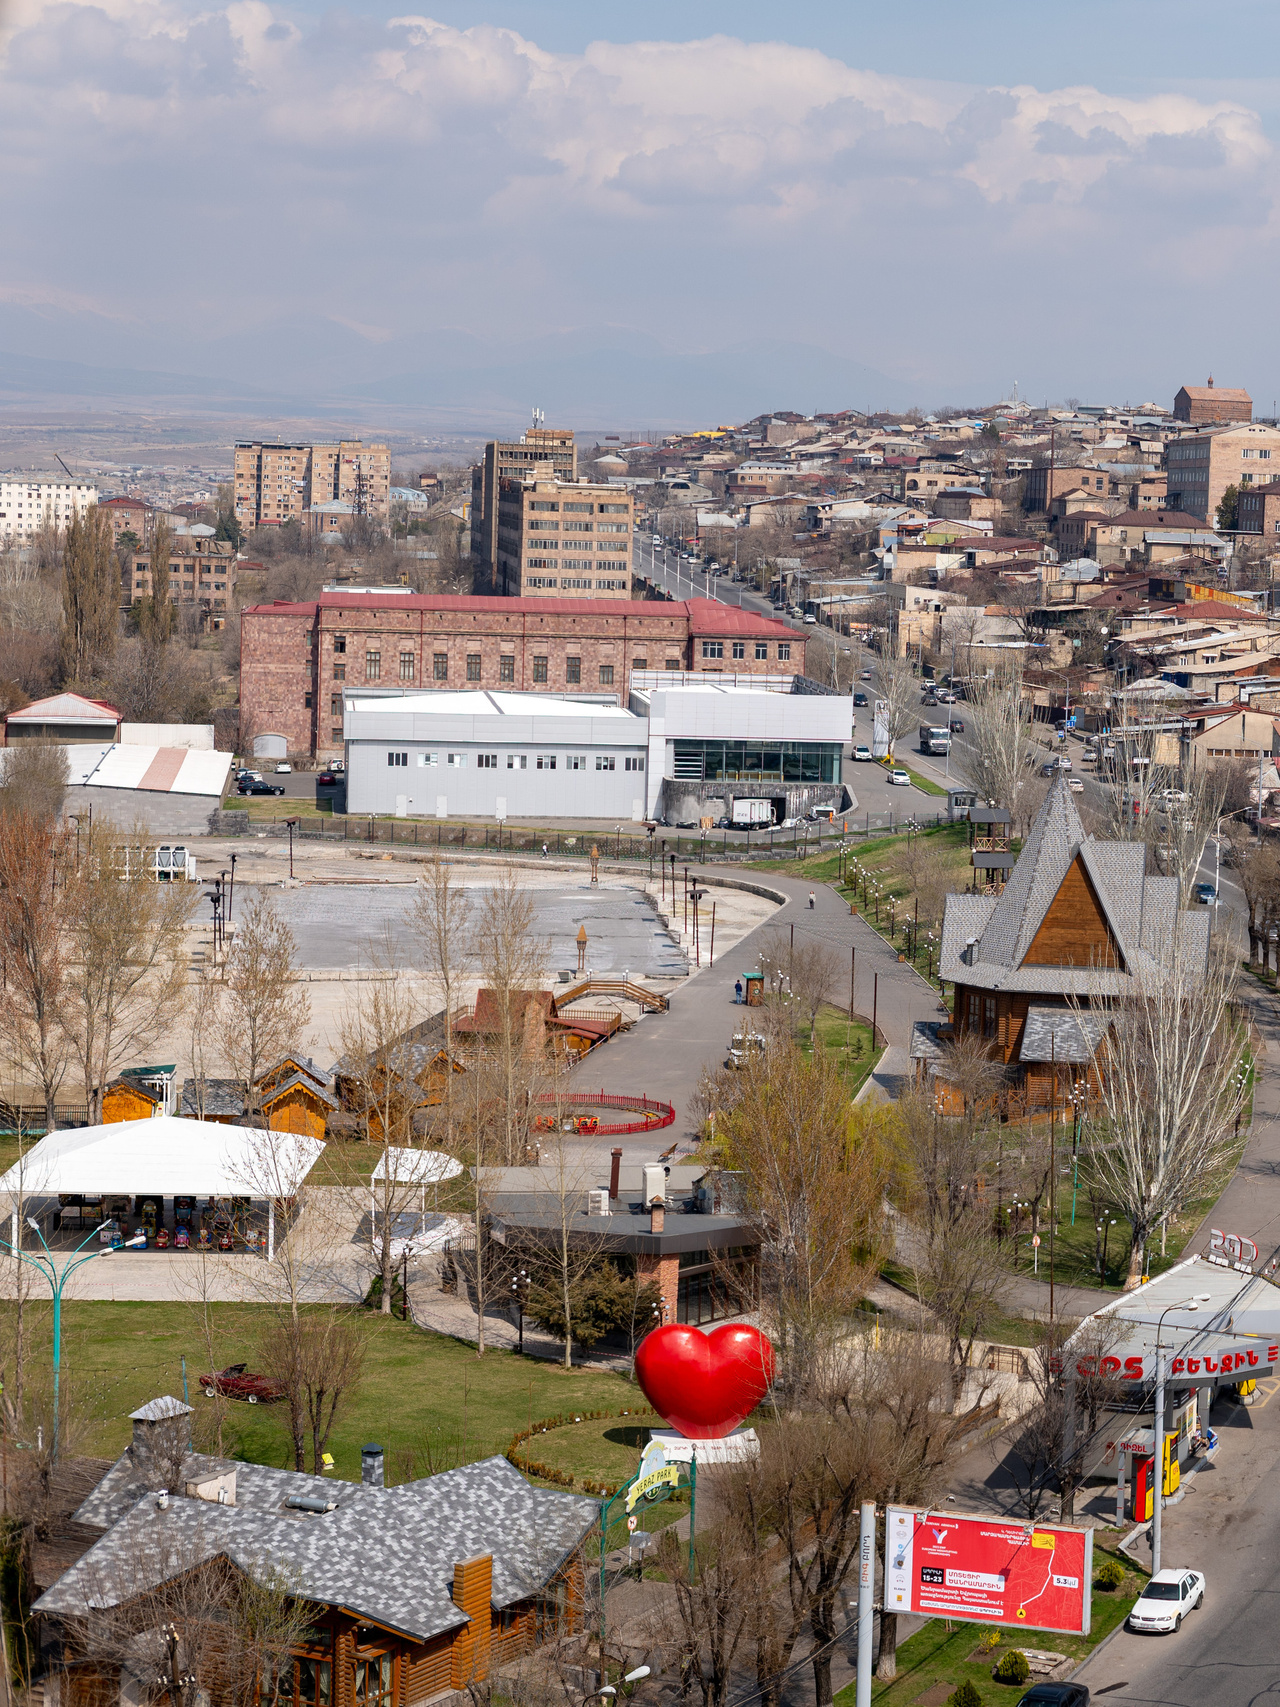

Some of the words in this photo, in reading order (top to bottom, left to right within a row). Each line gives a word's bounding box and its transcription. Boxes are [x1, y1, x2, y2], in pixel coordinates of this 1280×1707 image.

[1172, 1349, 1259, 1374] ԲԵՆԶԻՆ
[1120, 1442, 1147, 1453] ԴԻԶԵԼ
[636, 1474, 655, 1494] YERAZ
[656, 1468, 672, 1482] PARK
[922, 1574, 942, 1582] 15-23
[948, 1571, 981, 1579] ՄՈՏԵՑԻՐ
[948, 1578, 1001, 1590] ԾԱՆՐԱՄԱՐՏԻՆ
